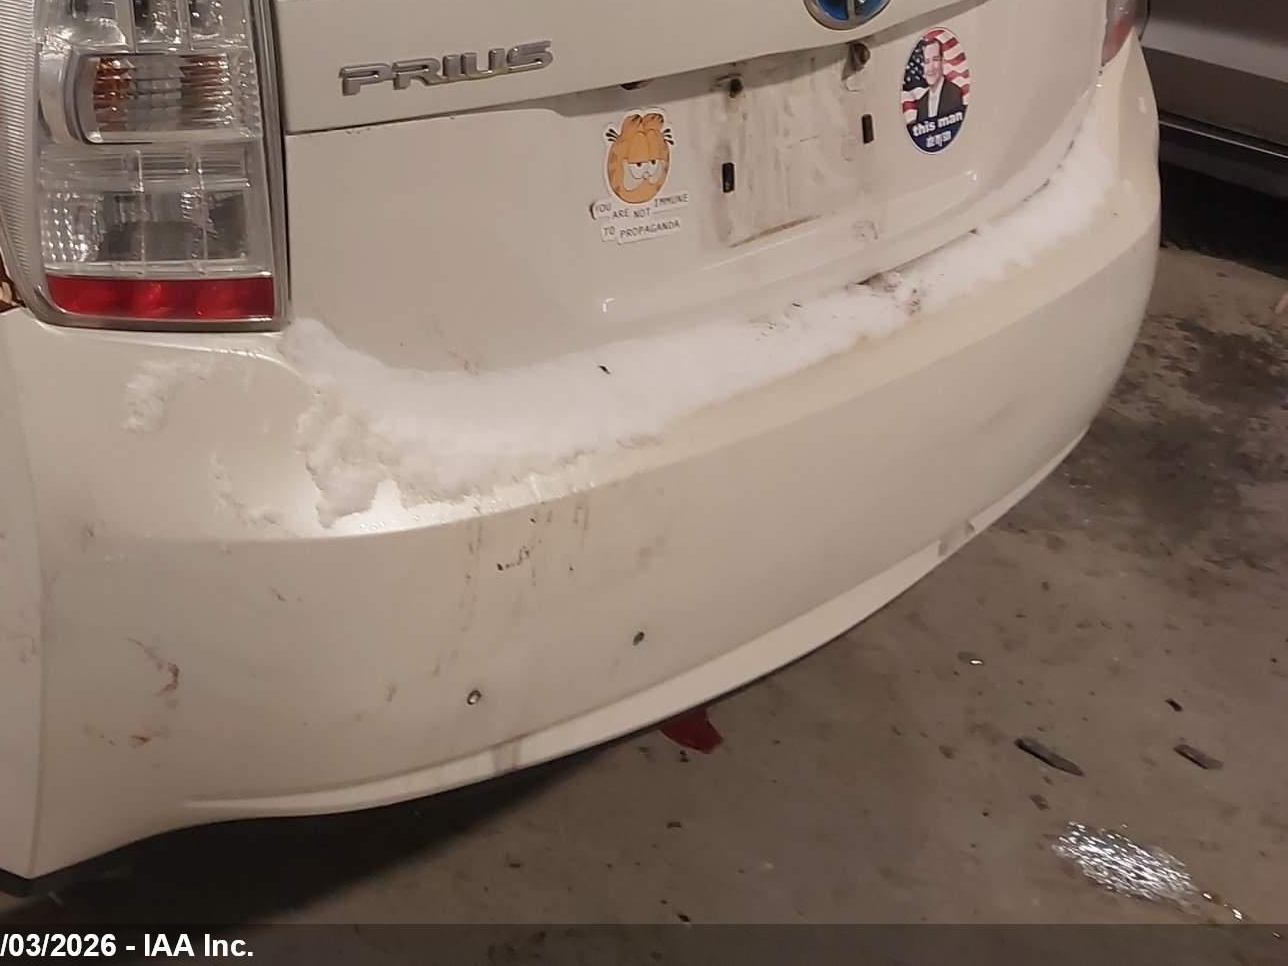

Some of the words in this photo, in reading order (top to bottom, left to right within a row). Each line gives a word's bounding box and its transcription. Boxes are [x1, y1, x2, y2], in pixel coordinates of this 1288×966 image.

[338, 40, 554, 97] PRIUS
[913, 121, 936, 136] this
[938, 112, 963, 128] man
[613, 208, 630, 218] ARE
[633, 207, 651, 218] NOT
[603, 225, 616, 236] TO
[620, 220, 680, 238] PROPAGANDA
